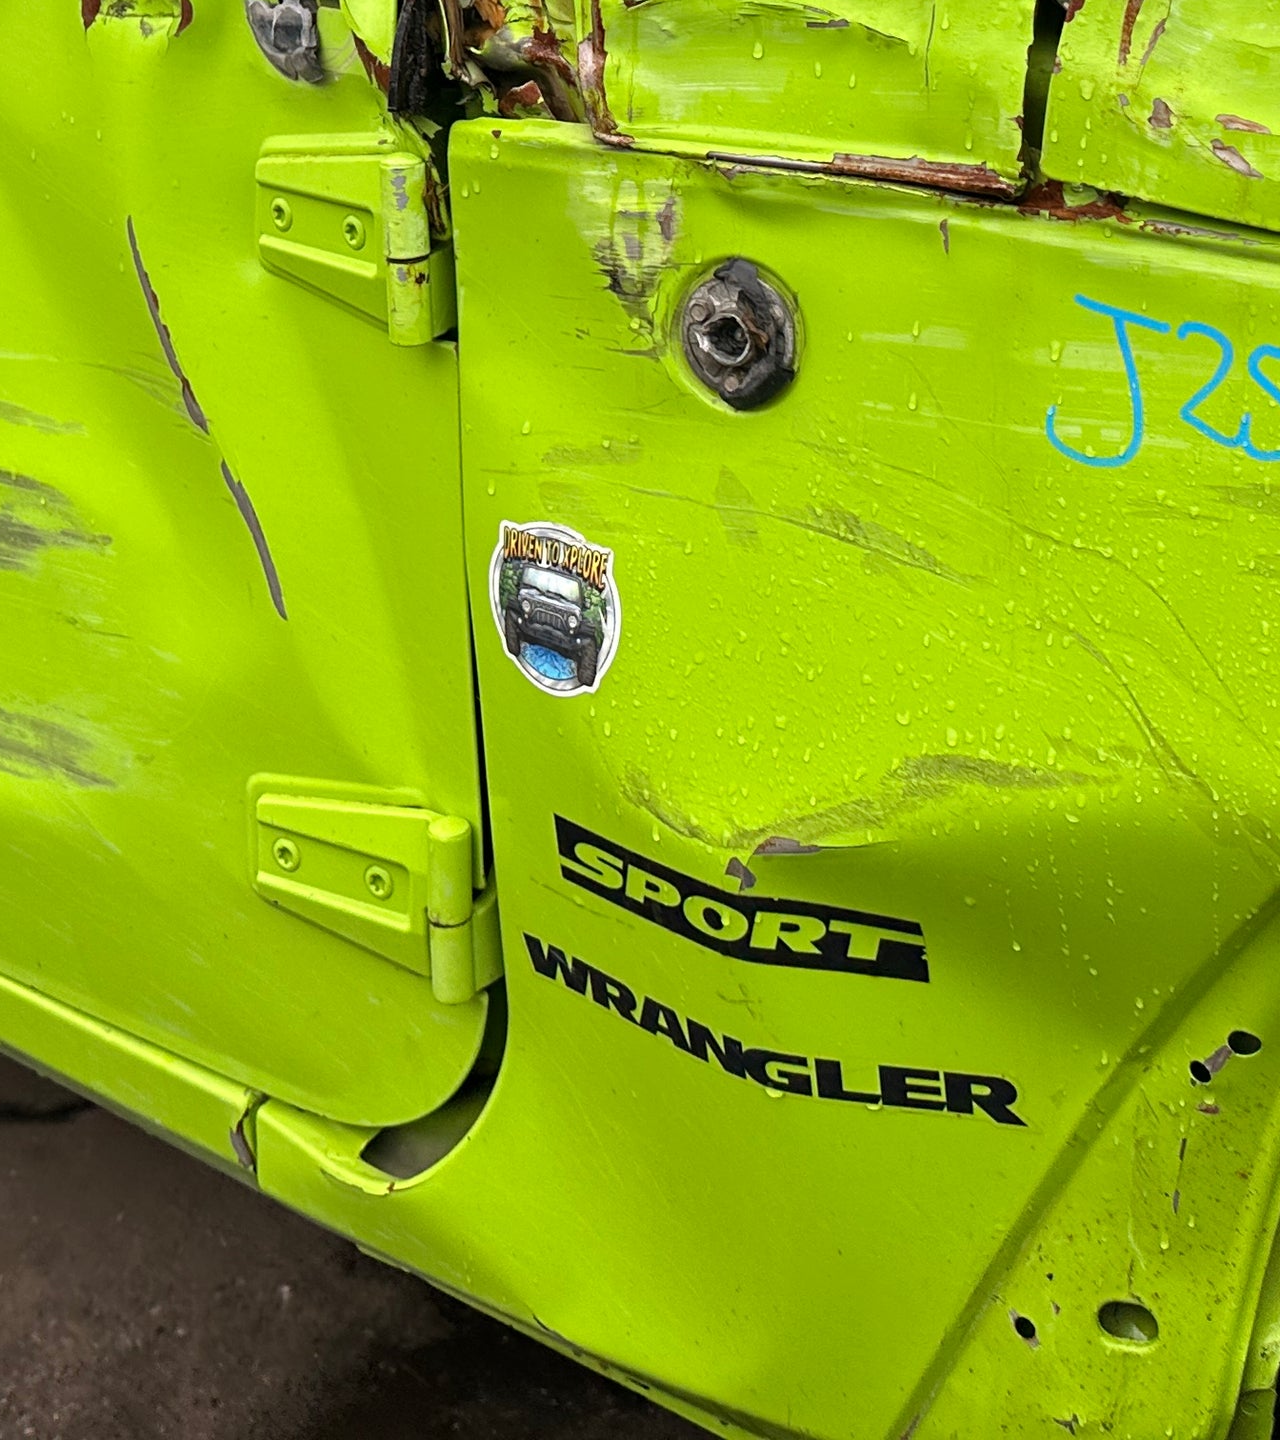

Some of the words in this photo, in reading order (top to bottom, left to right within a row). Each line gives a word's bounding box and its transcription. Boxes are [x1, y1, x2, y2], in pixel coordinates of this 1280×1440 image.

[503, 526, 544, 561] DRIVEN
[546, 540, 561, 565] TO
[563, 544, 609, 589] XPLORE
[572, 841, 926, 961] SPORT
[522, 931, 1029, 1128] WRANGLER
